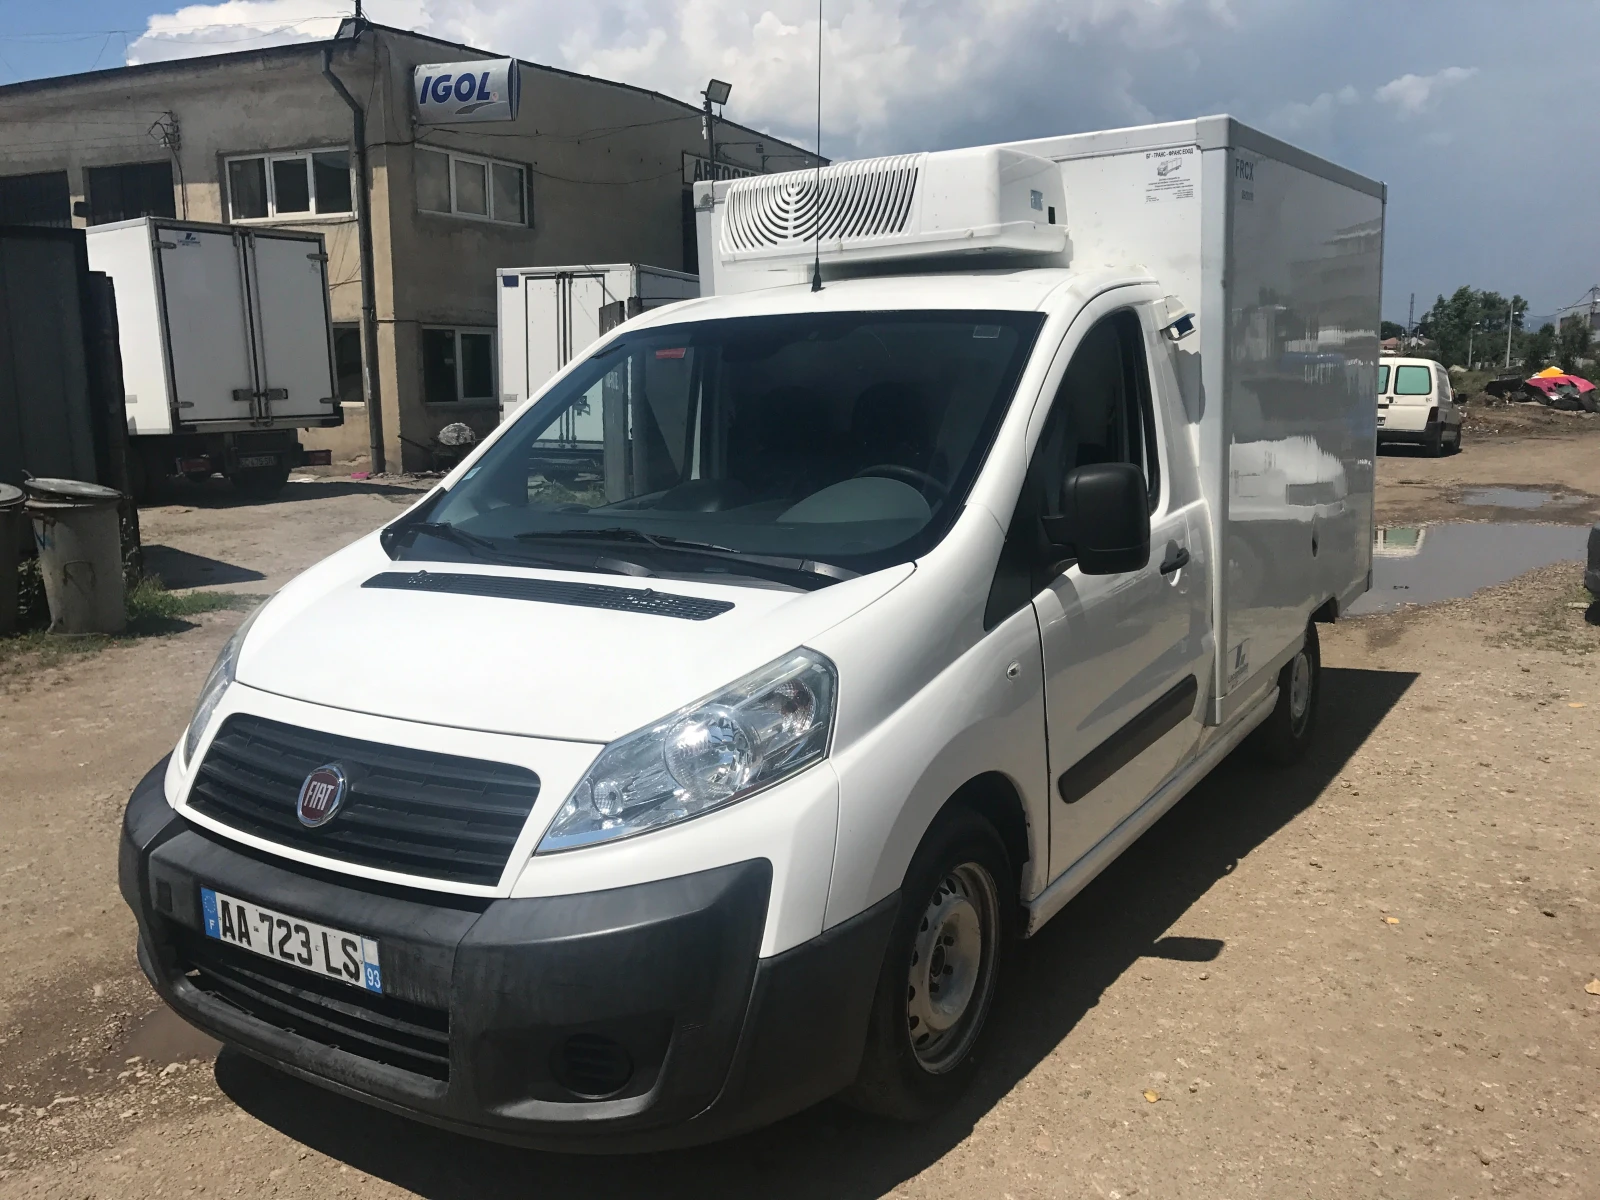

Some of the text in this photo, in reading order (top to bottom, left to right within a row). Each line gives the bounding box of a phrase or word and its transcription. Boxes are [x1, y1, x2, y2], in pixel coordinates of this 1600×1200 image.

[420, 71, 491, 104] IGOL
[1235, 158, 1254, 181] FRCX
[303, 780, 335, 811] FIAT
[367, 967, 381, 989] 93
